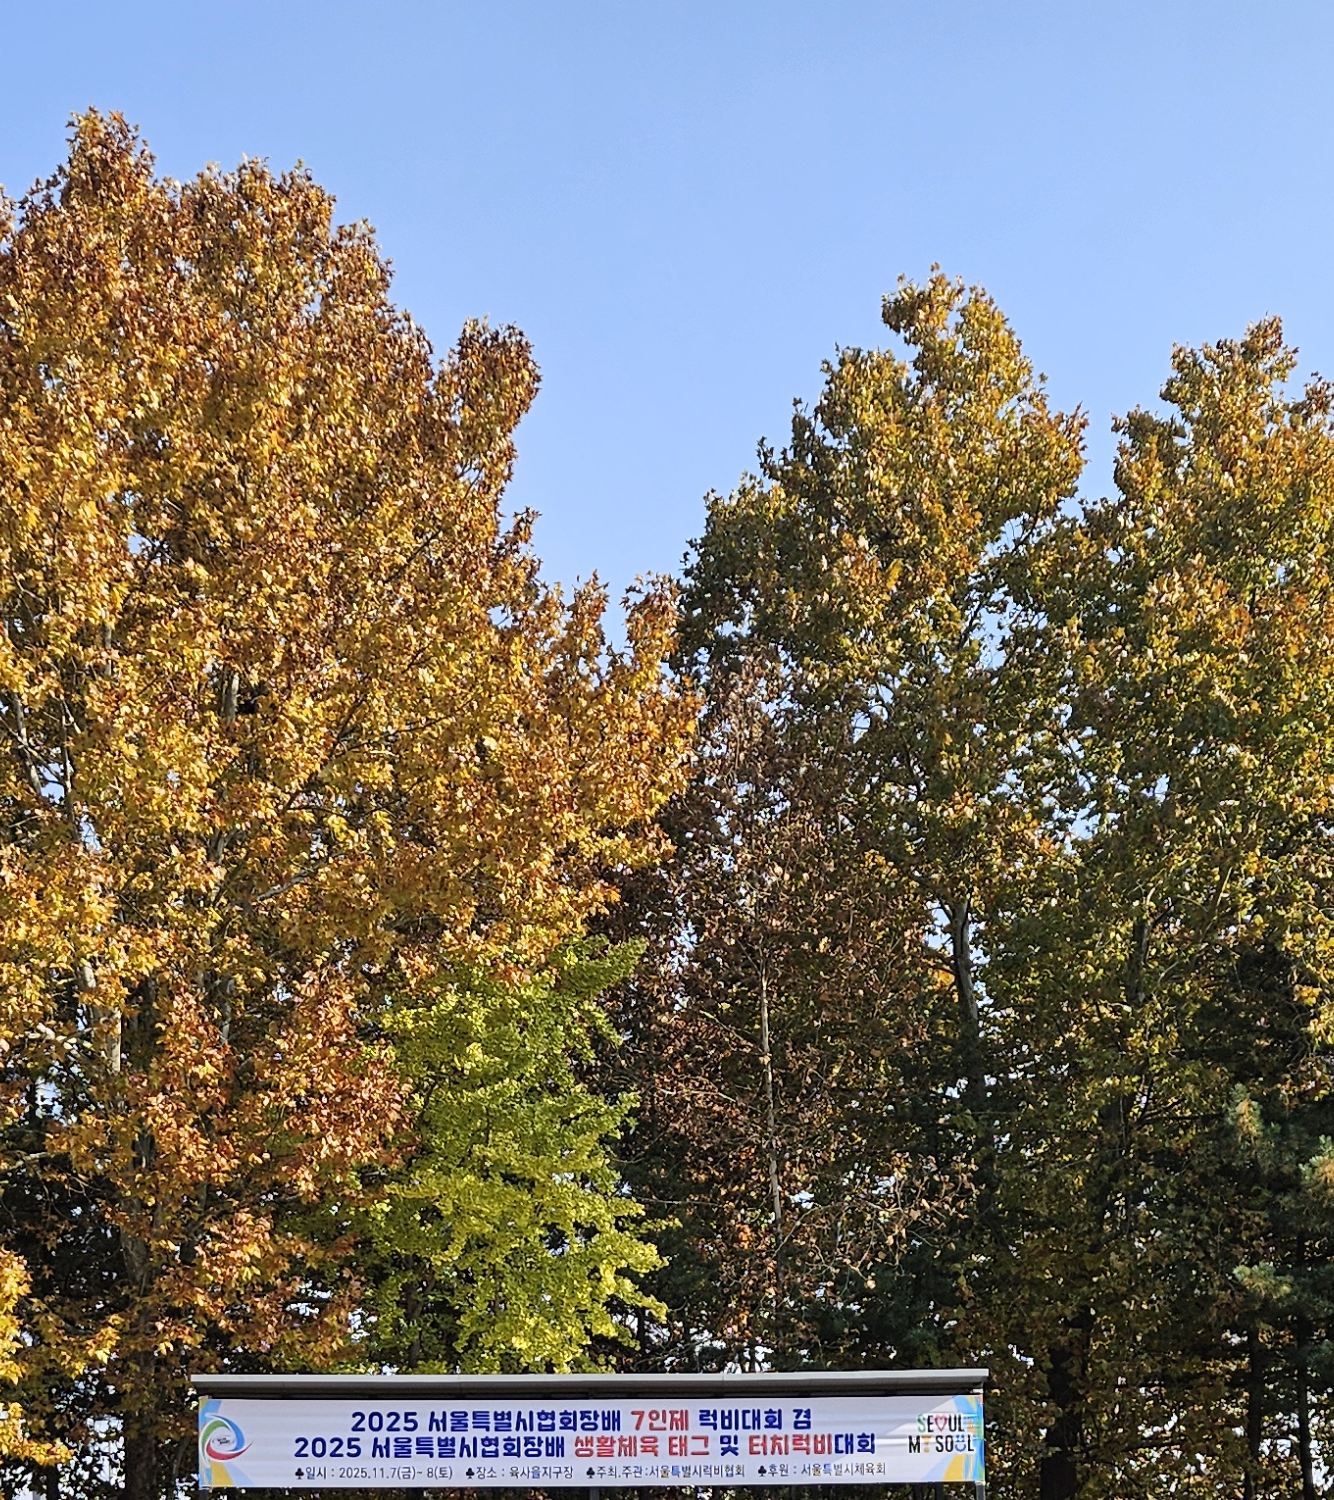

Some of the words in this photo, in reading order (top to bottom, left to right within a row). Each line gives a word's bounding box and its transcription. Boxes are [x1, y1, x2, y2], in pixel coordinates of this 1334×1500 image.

[351, 1411, 418, 1432] 2025
[429, 1410, 621, 1432] 서울특별시협회장배
[630, 1409, 689, 1431] 7인제
[698, 1408, 783, 1431] 럭비대회
[792, 1408, 812, 1430] 겸
[294, 1437, 362, 1458] 2025
[371, 1436, 565, 1458] 서울특별시협회장배
[574, 1435, 659, 1457] 생활체육
[668, 1435, 710, 1457] 태그
[719, 1435, 740, 1457] 및
[748, 1432, 876, 1456] 터치럭비대회
[305, 1466, 327, 1480] 일시
[426, 1466, 453, 1481] 8(토)
[475, 1466, 498, 1480] 장소
[509, 1465, 574, 1480] 육사을지구장
[767, 1463, 789, 1478] 후원
[800, 1462, 886, 1477] 서울특별시체육회
